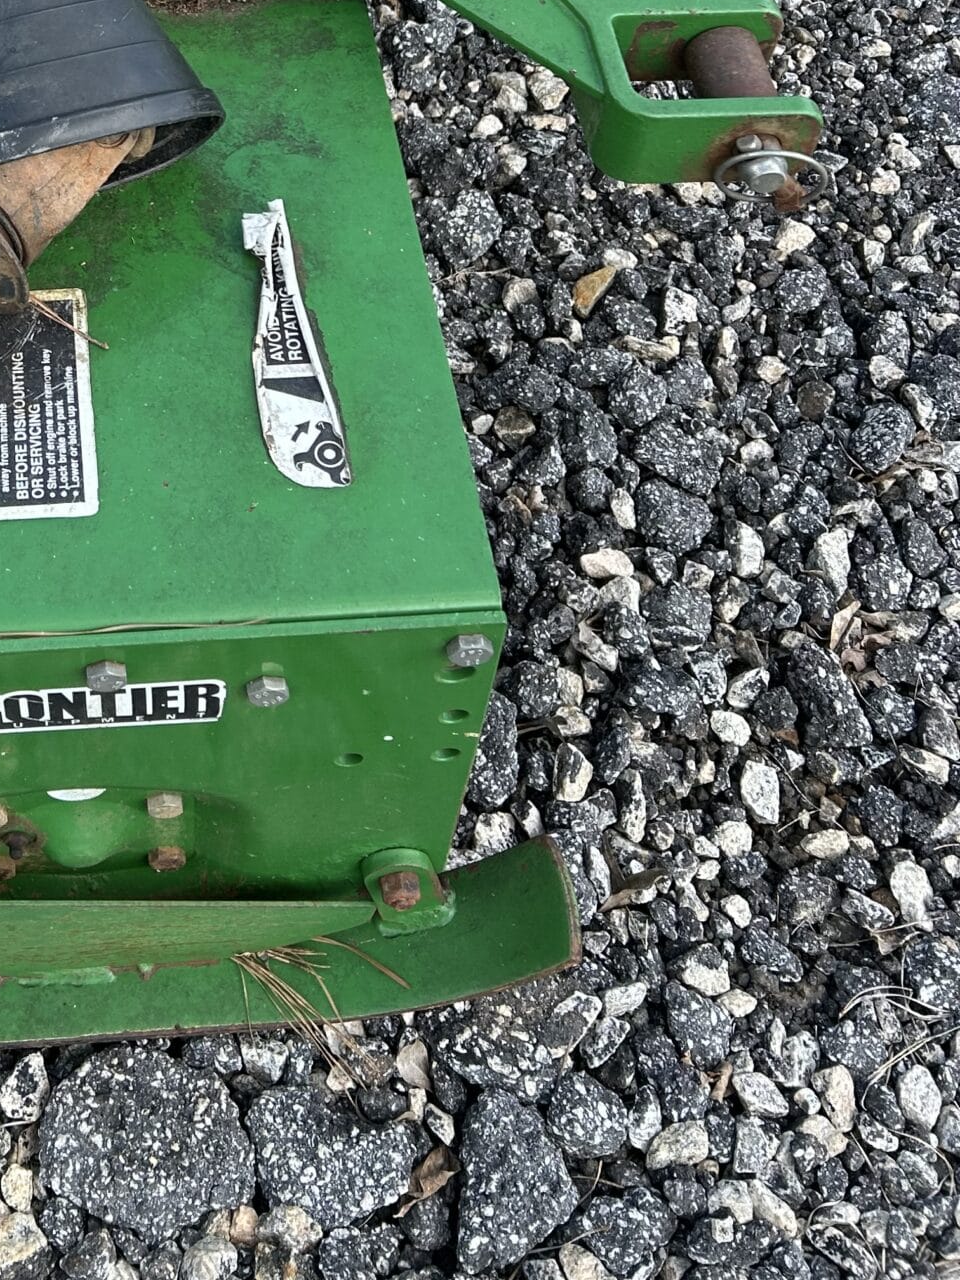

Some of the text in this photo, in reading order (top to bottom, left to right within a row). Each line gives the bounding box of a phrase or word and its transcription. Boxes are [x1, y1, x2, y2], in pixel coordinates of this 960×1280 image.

[266, 316, 285, 362] AVOID
[277, 287, 303, 361] ROTATING
[0, 444, 9, 466] from
[11, 352, 29, 500] BEFORE DISMOUNTING
[28, 404, 44, 499] OR SERVICING
[41, 349, 57, 489] Shut off engine and remove key
[54, 400, 69, 489] Lock brake for park
[64, 366, 80, 488] Lower or block up machine
[1, 468, 11, 492] away
